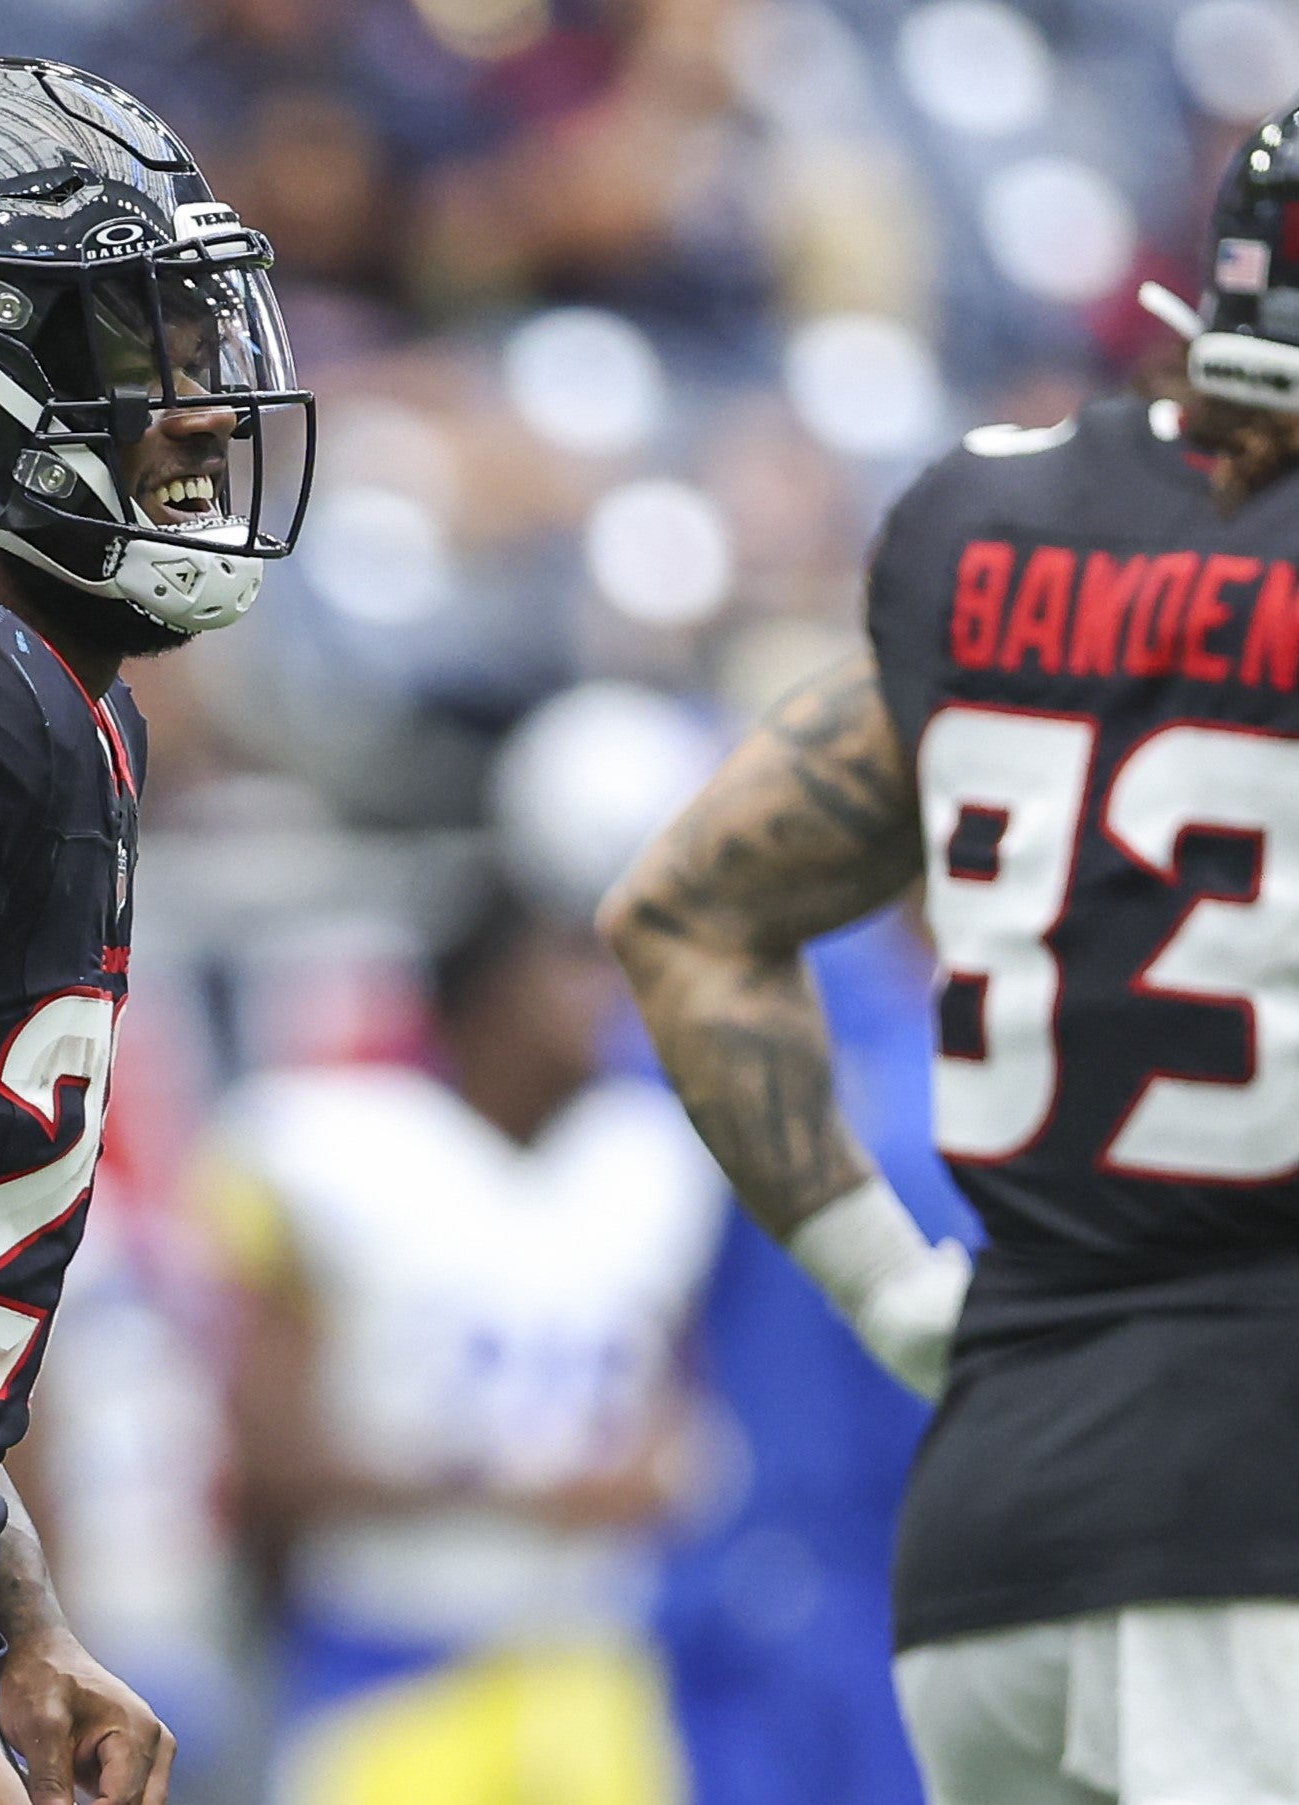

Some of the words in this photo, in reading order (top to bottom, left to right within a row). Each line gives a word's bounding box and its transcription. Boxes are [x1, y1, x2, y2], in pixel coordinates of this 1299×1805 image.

[191, 212, 237, 226] TEX
[86, 239, 156, 260] OAKLEY
[917, 700, 1299, 1187] 83
